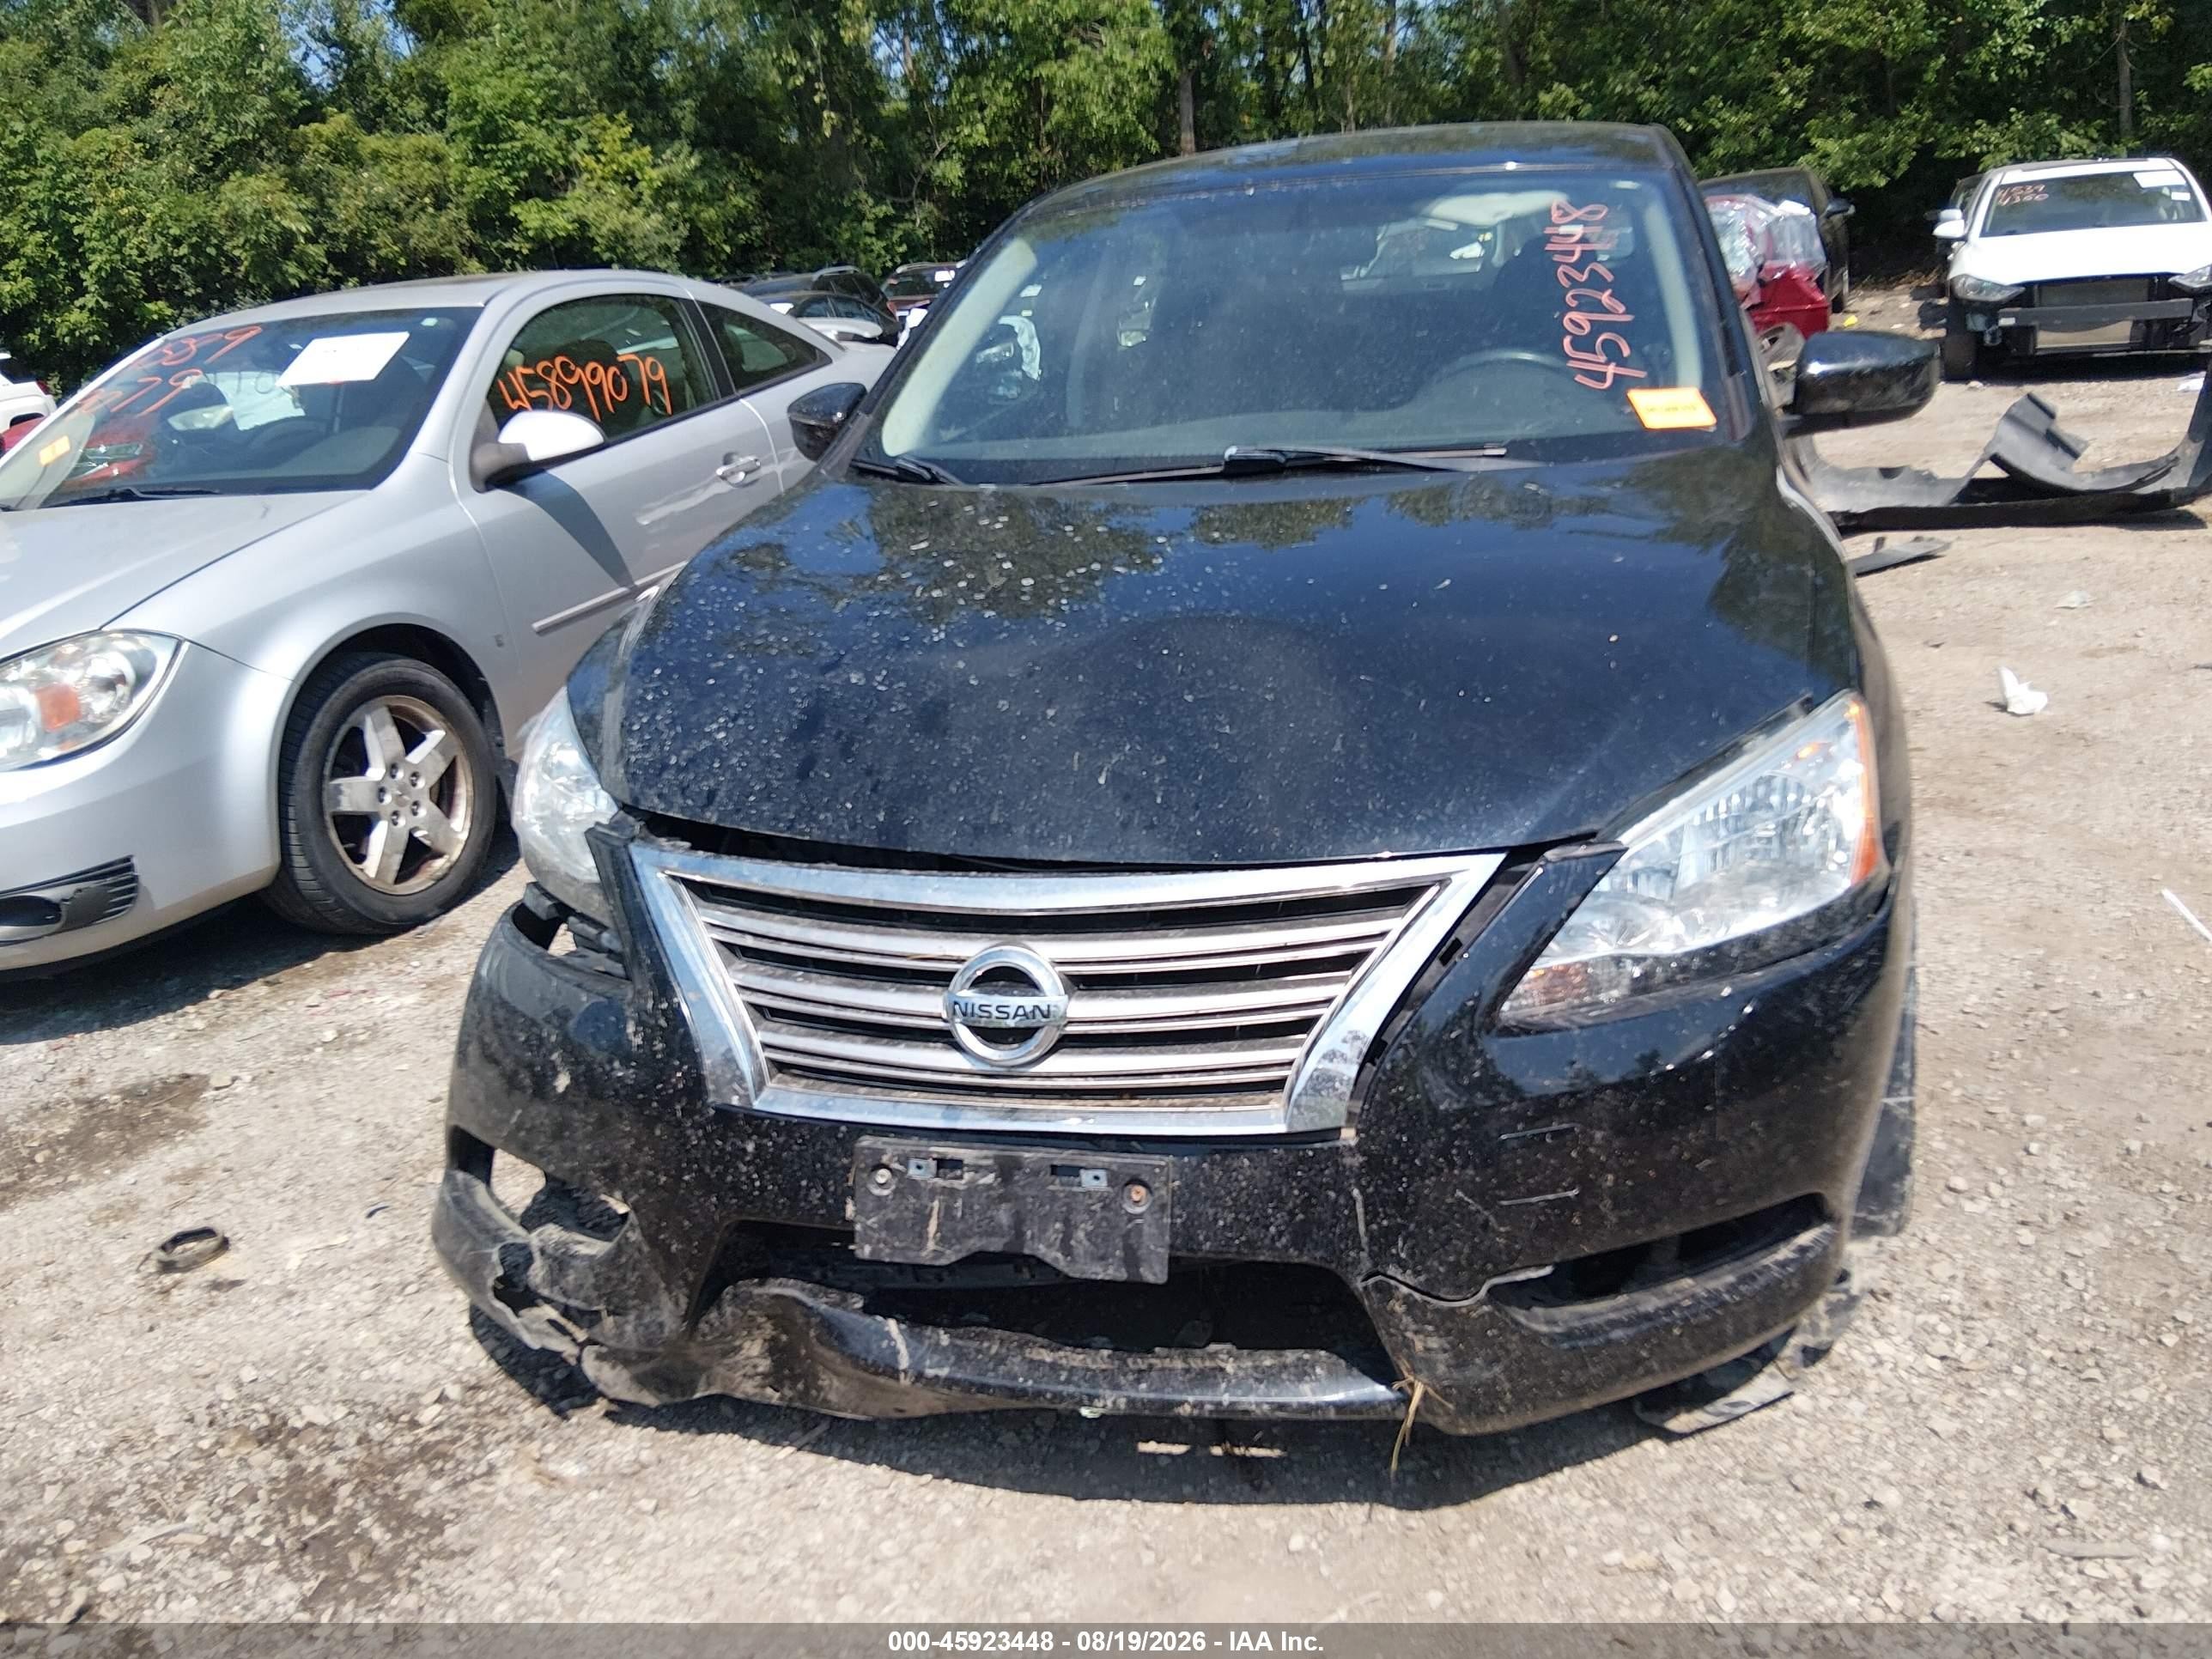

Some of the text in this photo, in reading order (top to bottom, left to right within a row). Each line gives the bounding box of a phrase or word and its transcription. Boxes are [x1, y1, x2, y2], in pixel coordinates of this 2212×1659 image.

[1543, 198, 1648, 390] 45923448
[497, 355, 672, 422] 45899079
[953, 1000, 1050, 1020] NISSAN
